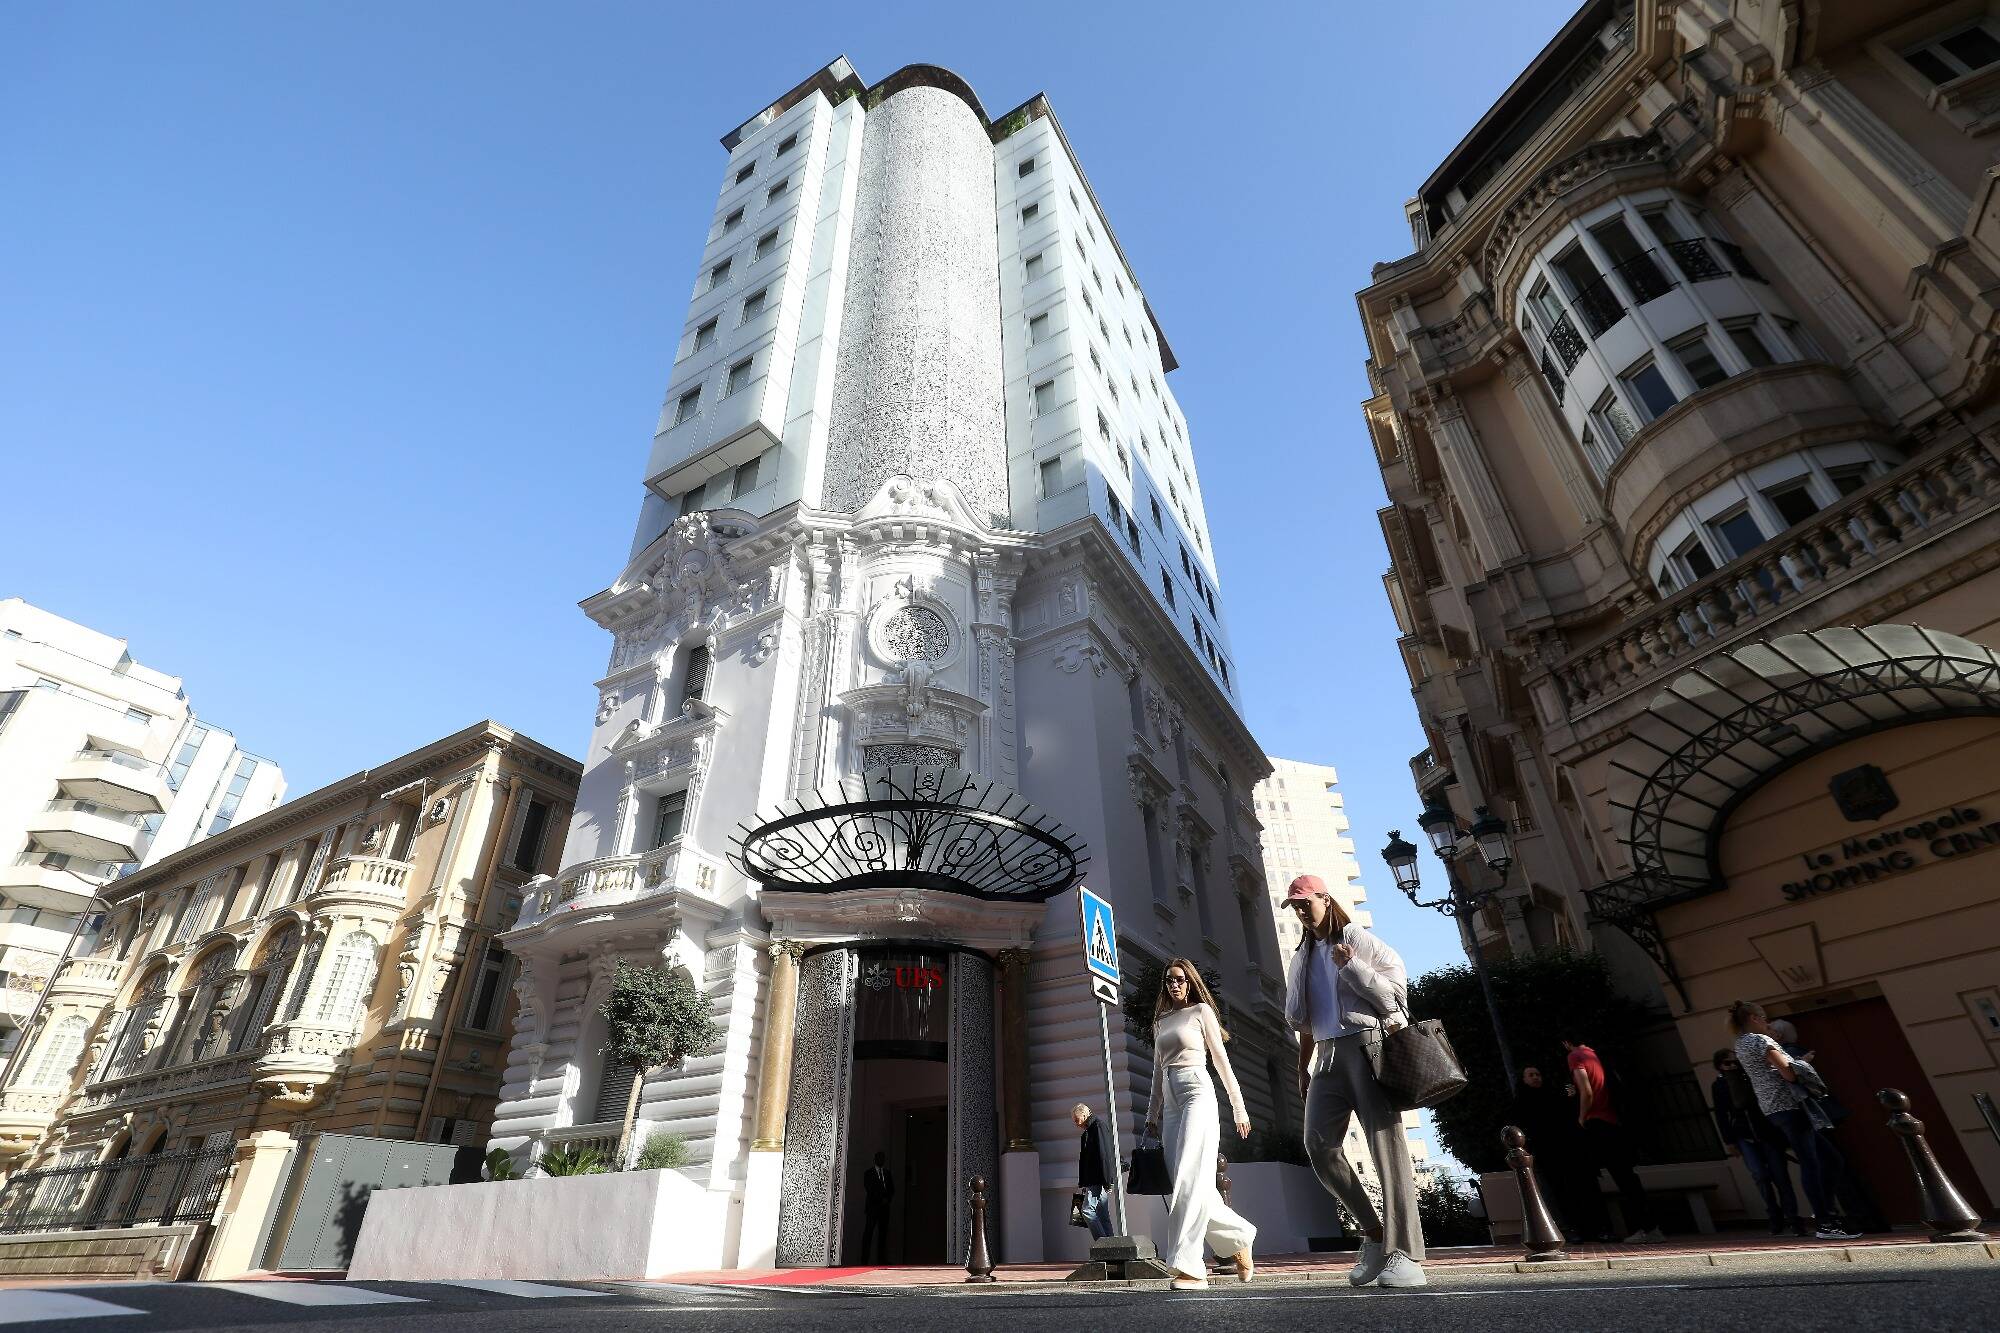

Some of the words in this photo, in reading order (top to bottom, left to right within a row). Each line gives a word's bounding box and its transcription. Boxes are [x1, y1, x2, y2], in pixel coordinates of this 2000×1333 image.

[1801, 853, 1834, 871] Le
[1841, 807, 1981, 860] Metropole
[1781, 850, 1914, 902] SHOPPING
[895, 965, 944, 990] UBS
